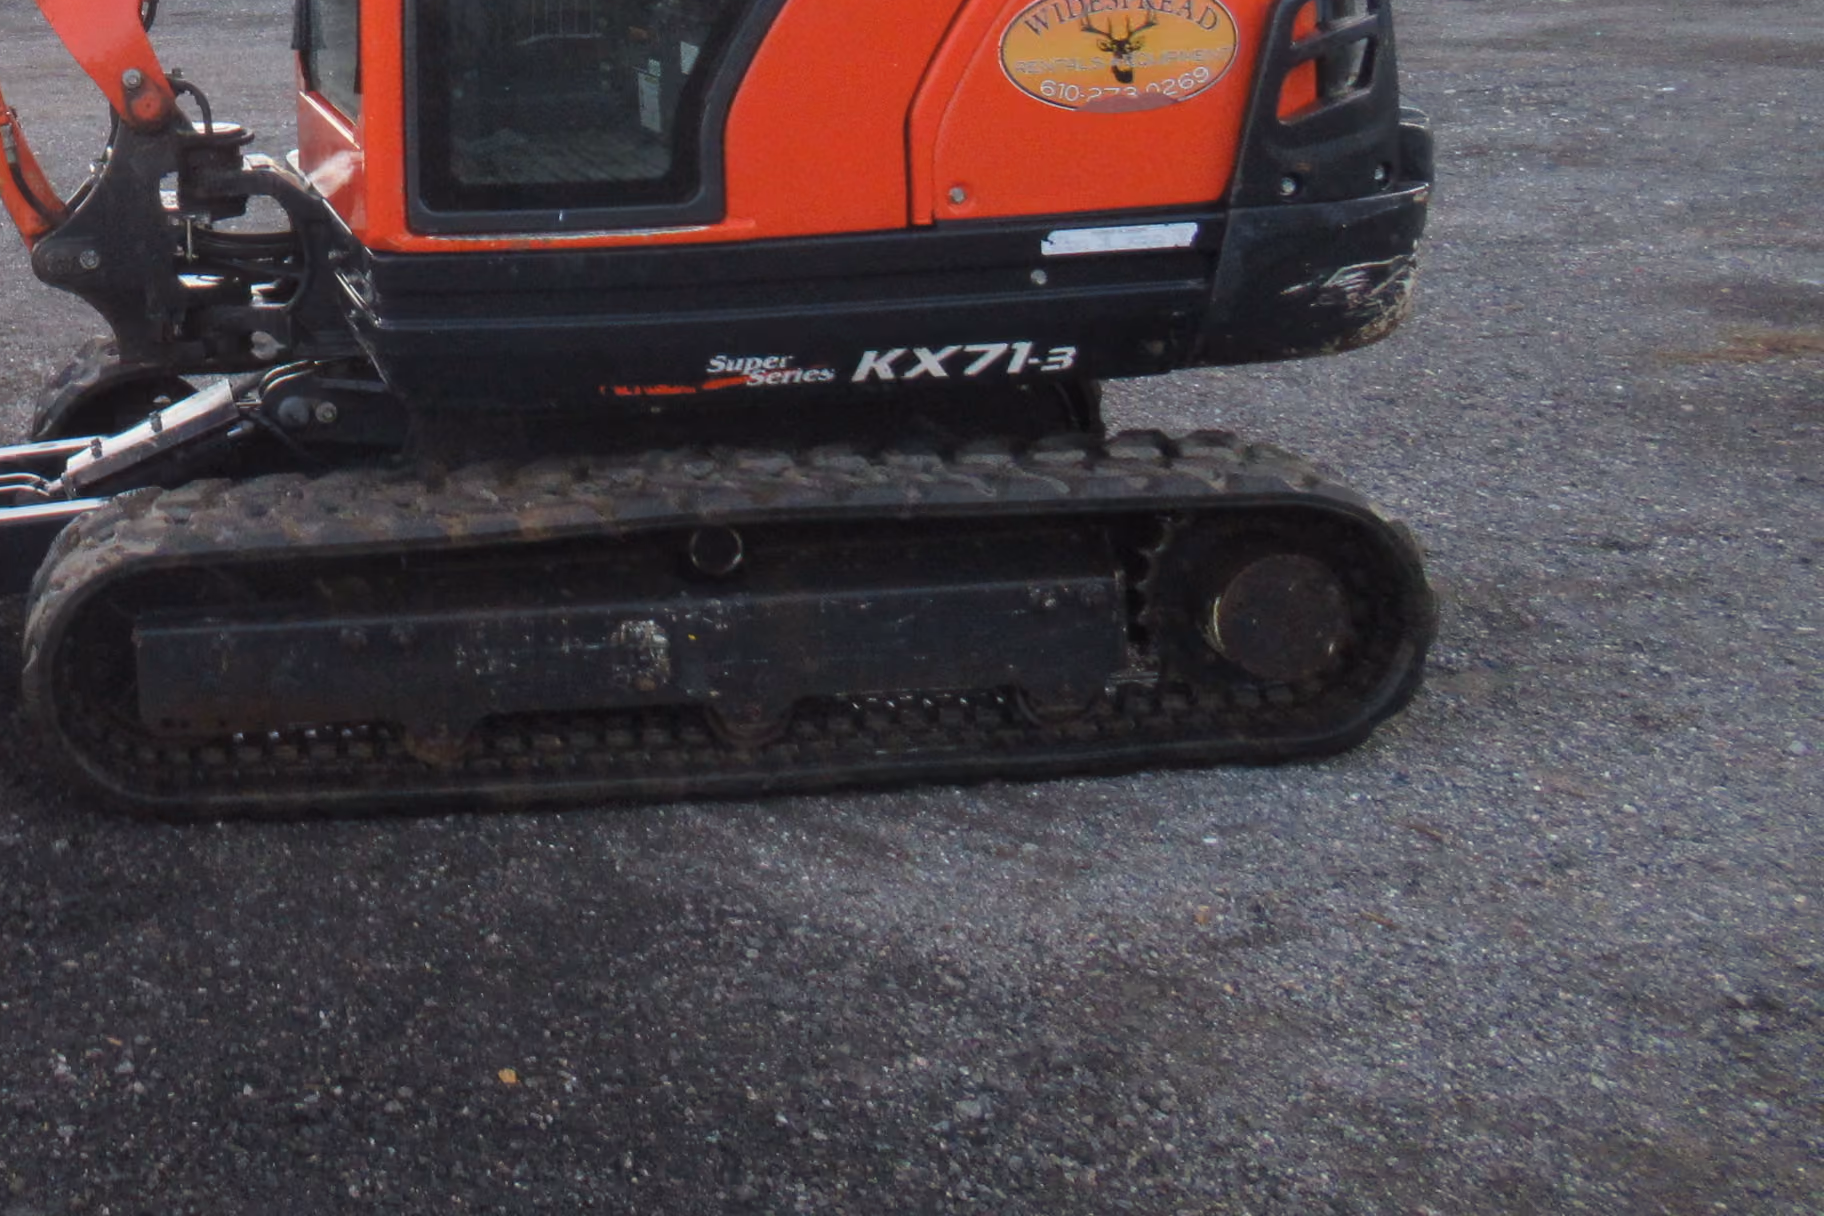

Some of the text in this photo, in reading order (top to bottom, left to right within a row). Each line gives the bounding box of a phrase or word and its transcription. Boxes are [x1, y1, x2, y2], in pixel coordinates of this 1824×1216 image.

[706, 355, 794, 374] Super
[851, 341, 1077, 382] KX71-3
[746, 368, 836, 386] Series
